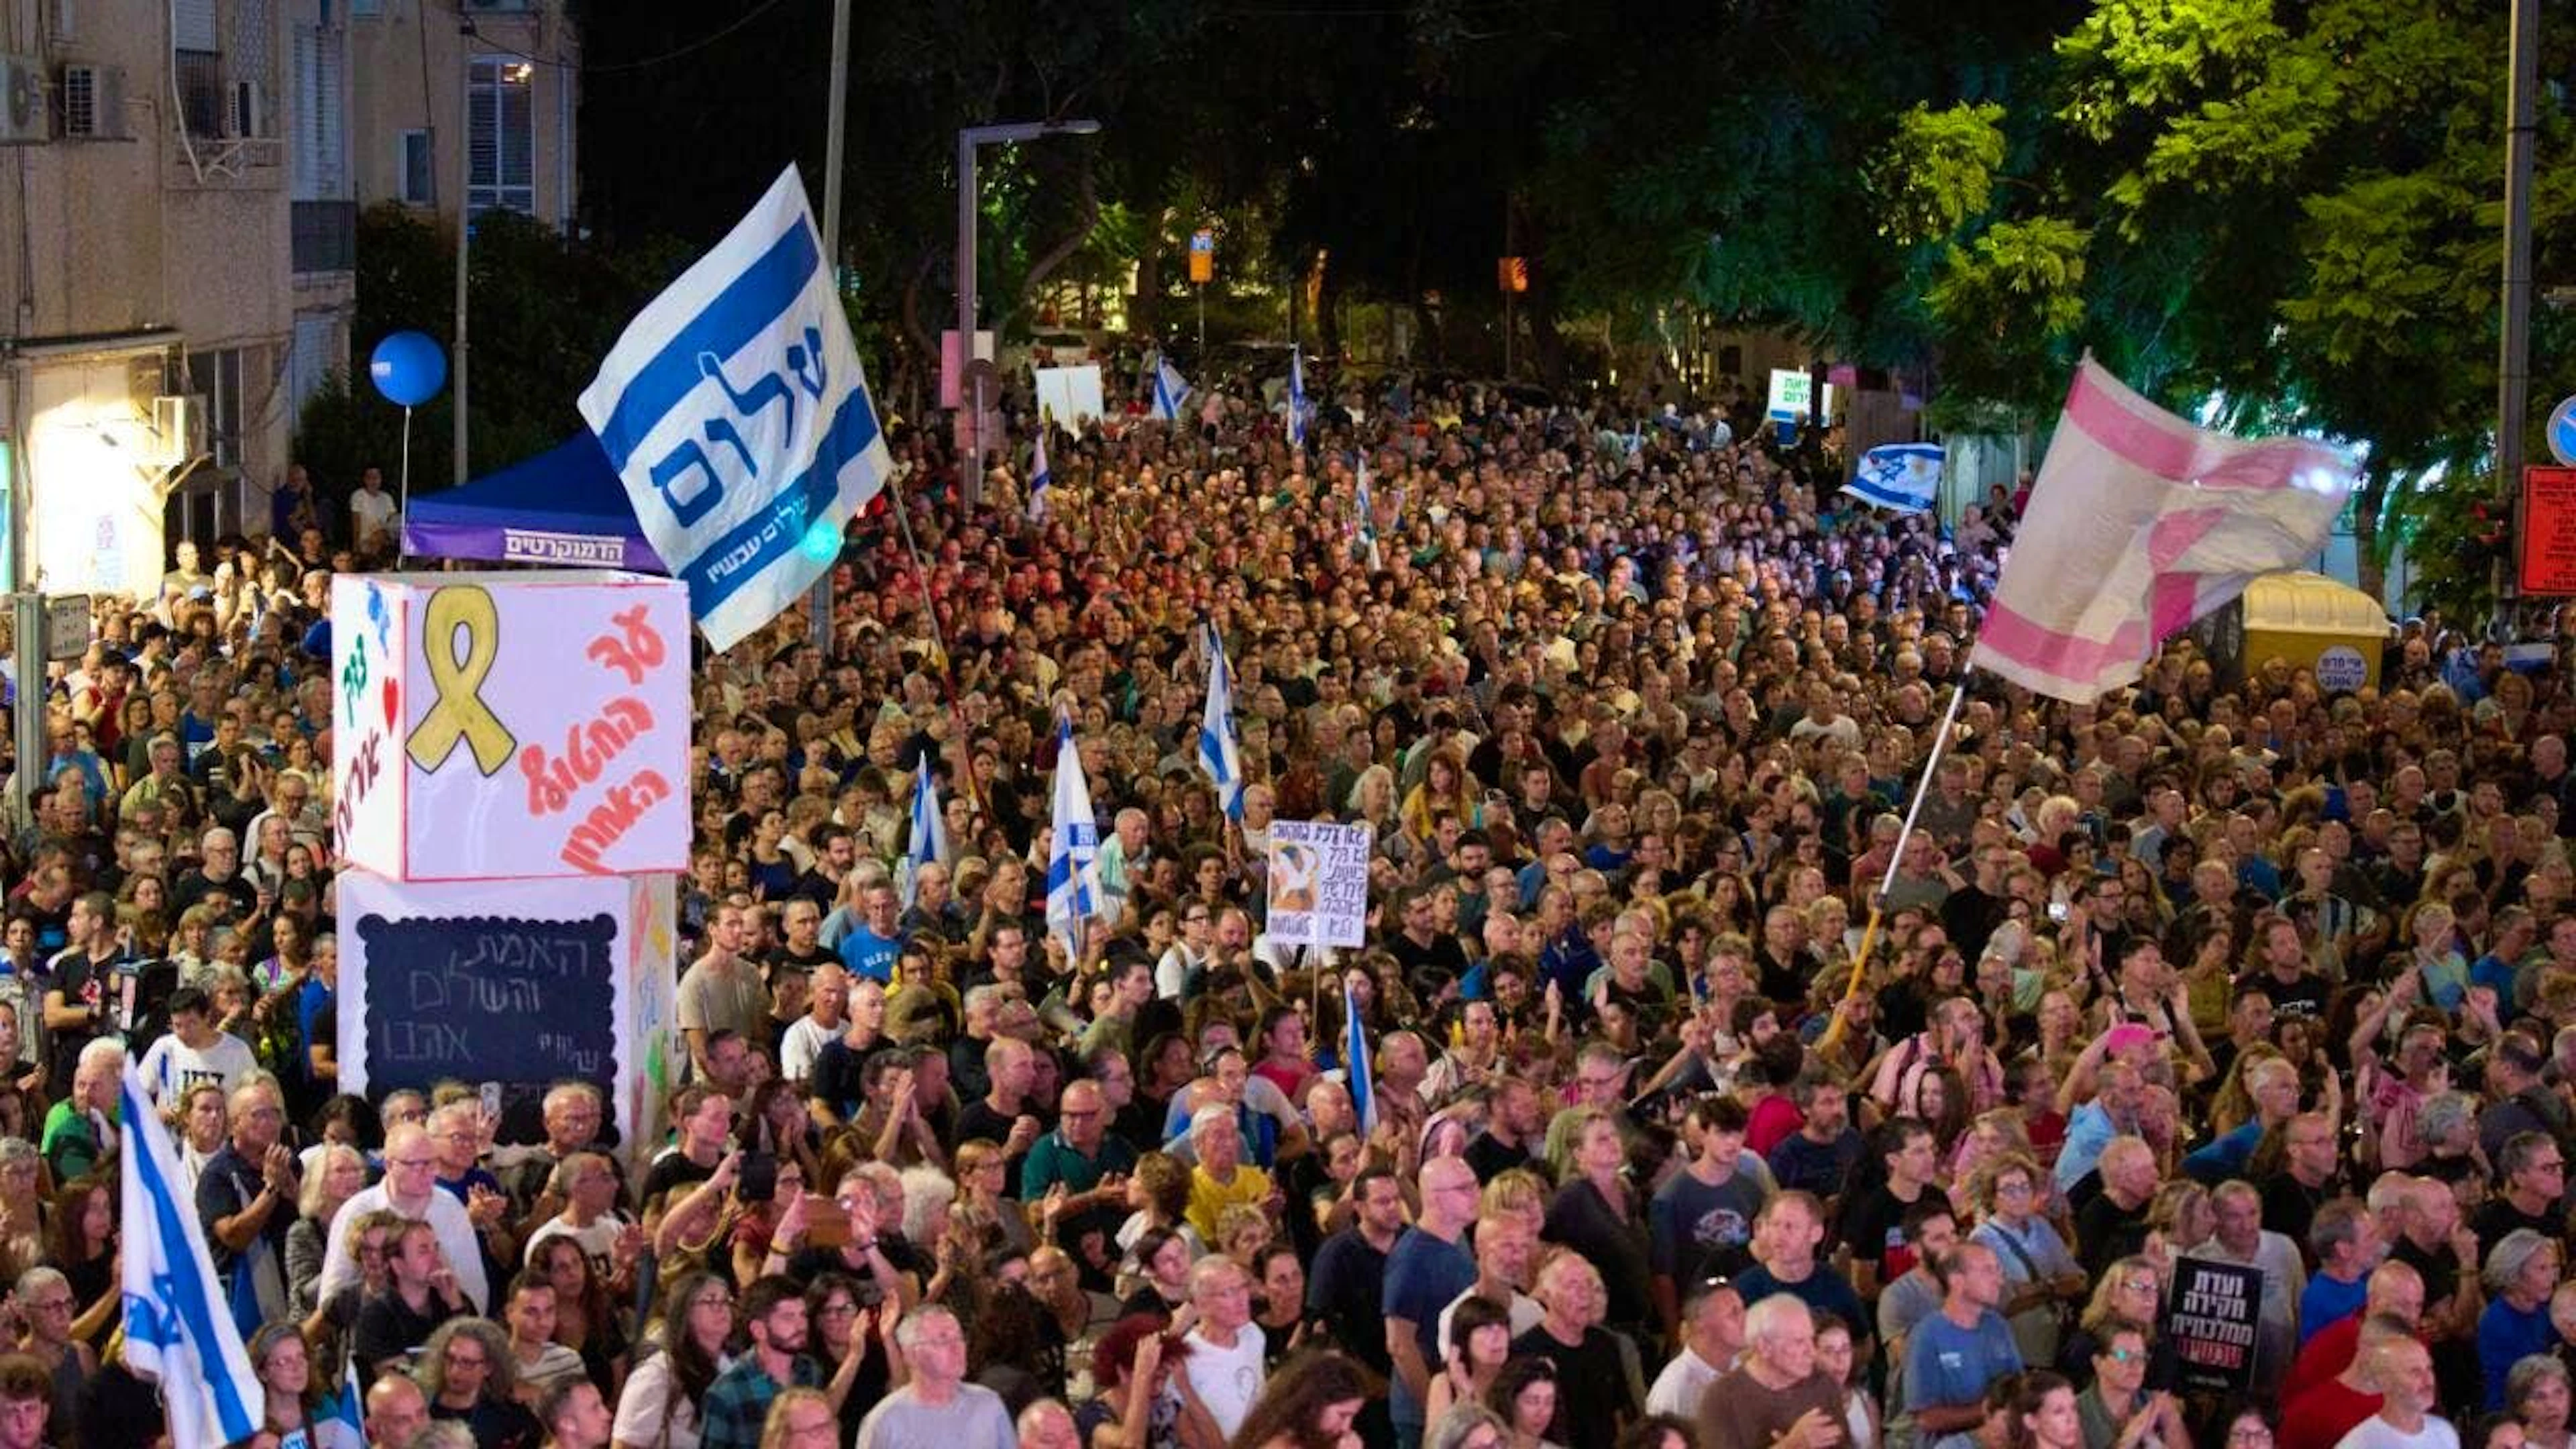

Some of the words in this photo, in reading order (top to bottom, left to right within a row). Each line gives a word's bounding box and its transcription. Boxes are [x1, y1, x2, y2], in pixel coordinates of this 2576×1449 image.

[649, 313, 826, 530] שלום
[761, 493, 809, 543] שלום
[506, 535, 625, 562] הדמוקרטים
[706, 535, 762, 584] עכשיו
[585, 603, 667, 685] עד
[519, 697, 656, 817] החטוף
[559, 769, 673, 875] האחרון
[464, 932, 588, 977] האמת
[409, 949, 542, 1014] והשלום
[382, 1022, 475, 1065] אהבו
[2182, 1291, 2247, 1320] חקירה
[2194, 1269, 2245, 1297] ועדת
[2170, 1313, 2254, 1346] ממלכתית
